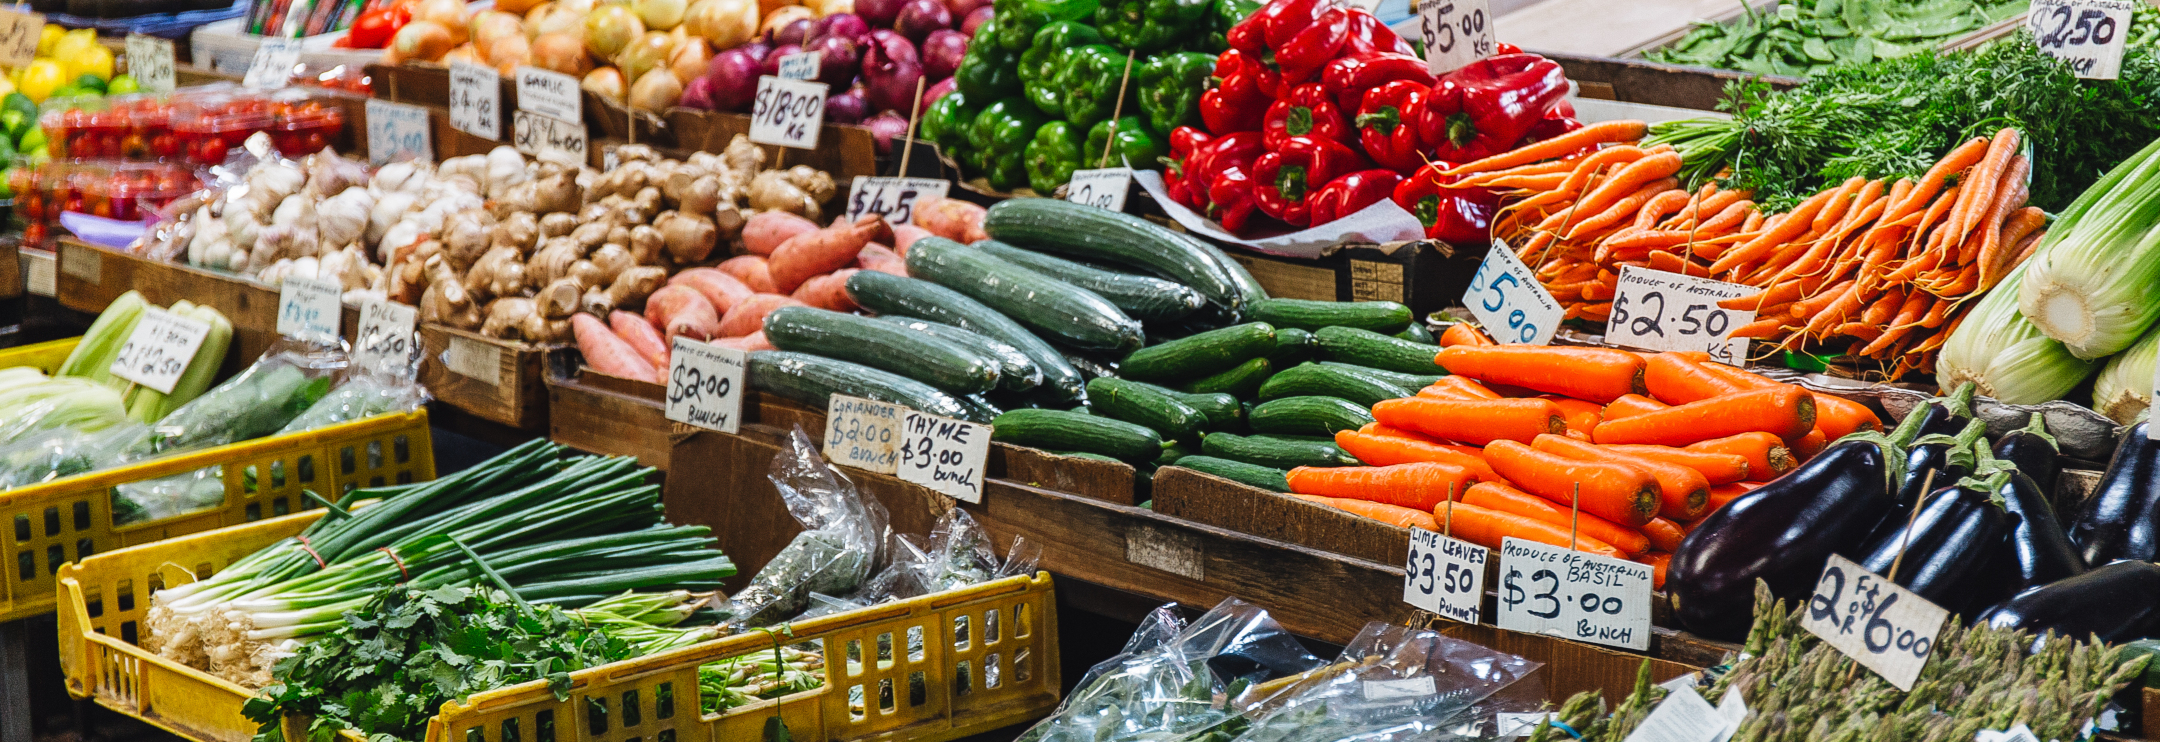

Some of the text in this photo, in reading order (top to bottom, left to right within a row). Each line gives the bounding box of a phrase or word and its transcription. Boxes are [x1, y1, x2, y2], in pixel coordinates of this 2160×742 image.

[1422, 3, 1485, 54] $5.00
[2030, 5, 2117, 49] $2.50
[1473, 33, 1491, 58] KG
[752, 81, 820, 126] $18.00
[783, 122, 806, 142] KG
[1620, 270, 1666, 287] PRODUCE
[1669, 281, 1685, 291] OF
[1611, 290, 1730, 339] $2.50
[1706, 342, 1734, 366] KG
[668, 357, 731, 412] $2.00
[688, 404, 728, 431] BUNCH
[833, 398, 897, 420] CORIANDER
[828, 411, 892, 450] $2.00
[905, 412, 973, 445] THYME
[849, 446, 899, 469] BUNCH
[901, 436, 964, 470] $3.00
[933, 465, 977, 494] bunch
[1411, 527, 1485, 565] LIME LEAVES
[1502, 540, 1649, 581] PRODUCE OF AUSTRALIA
[1406, 544, 1474, 595] $3.50
[1566, 566, 1624, 588] BASIL
[1502, 565, 1624, 619] $3.00
[1810, 566, 1846, 628] 2
[1859, 582, 1932, 660] $6.00
[1576, 618, 1633, 644] BUNCH
